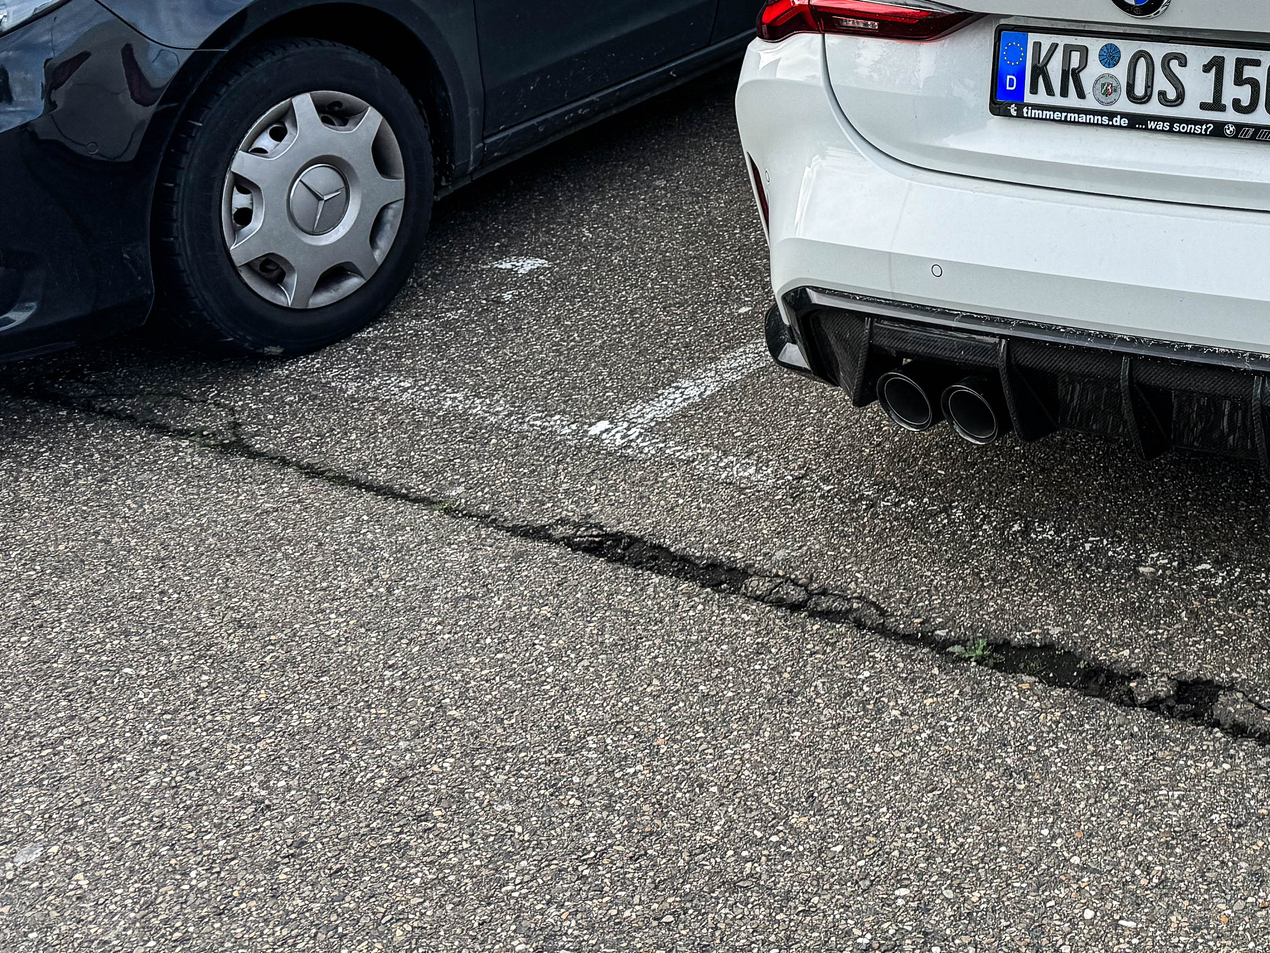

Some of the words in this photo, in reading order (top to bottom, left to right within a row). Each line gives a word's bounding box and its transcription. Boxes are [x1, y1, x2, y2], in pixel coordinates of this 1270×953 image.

[1006, 75, 1017, 90] D
[1029, 41, 1088, 99] KR
[1126, 50, 1187, 107] OS
[1022, 107, 1129, 127] timmermanns.de
[1172, 123, 1214, 135] sonst?
